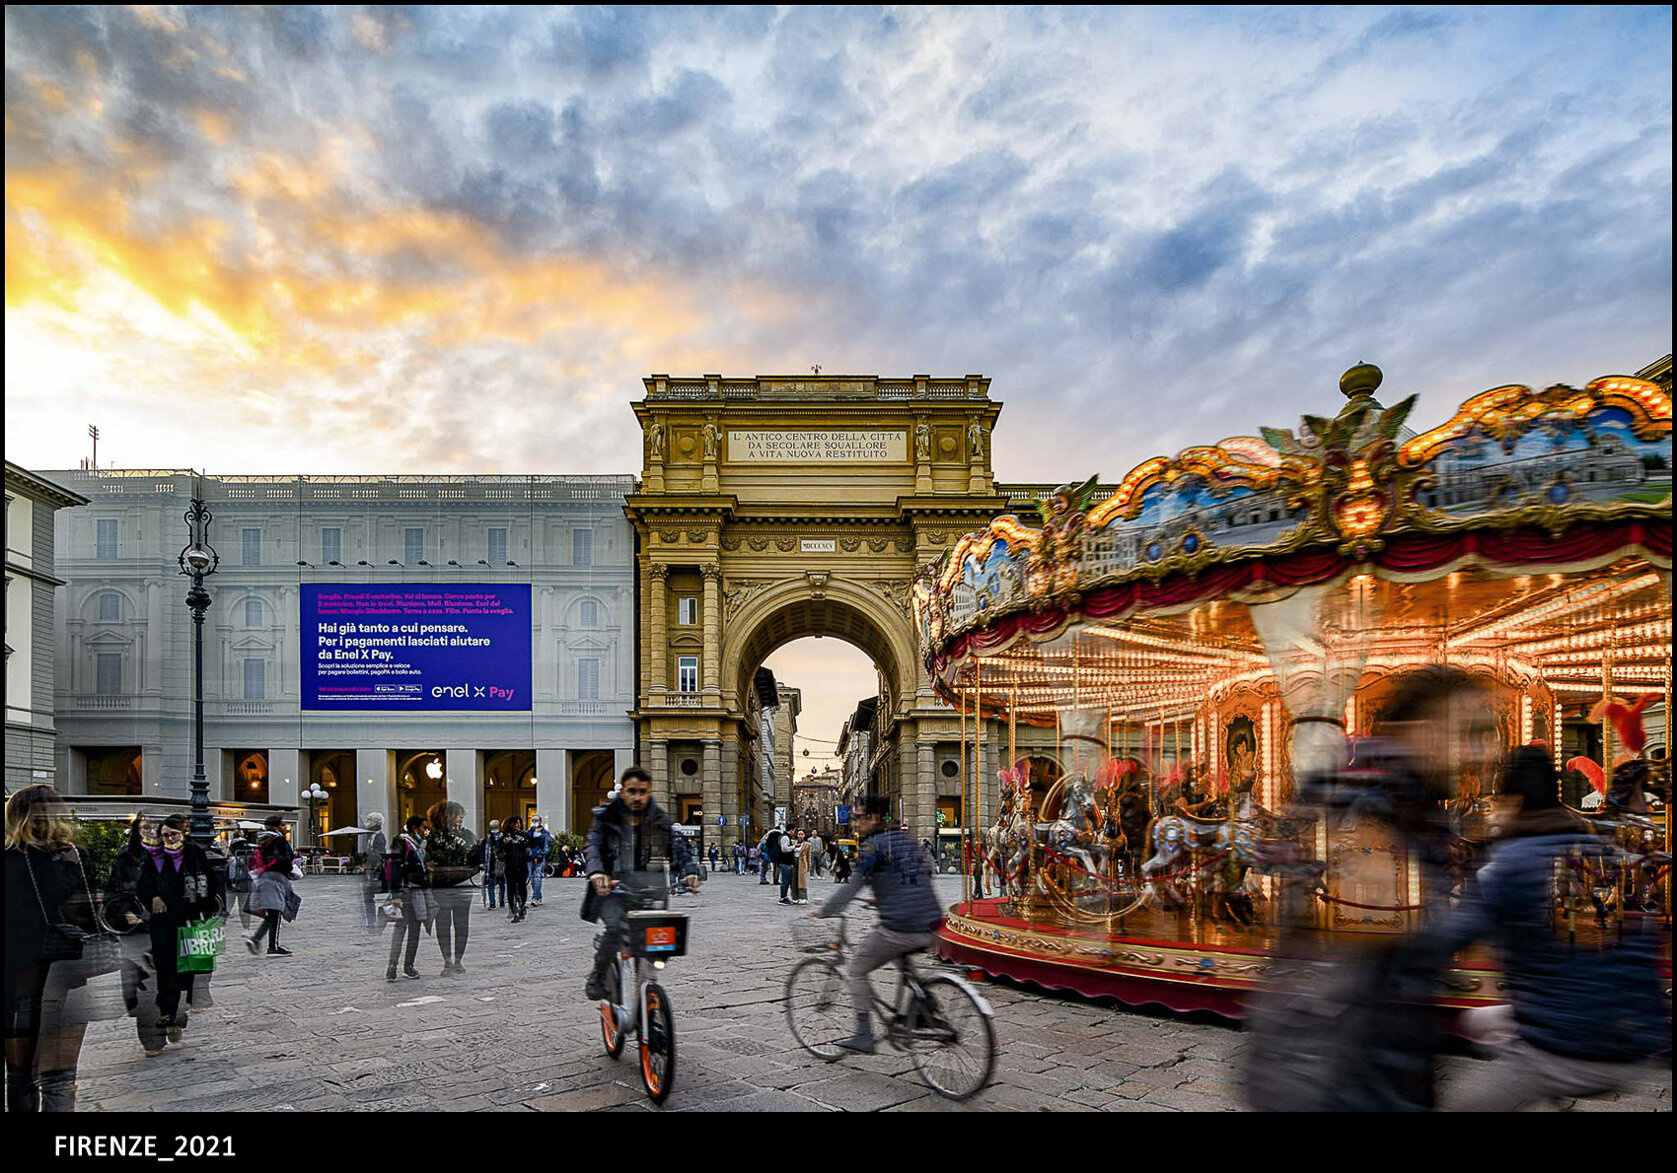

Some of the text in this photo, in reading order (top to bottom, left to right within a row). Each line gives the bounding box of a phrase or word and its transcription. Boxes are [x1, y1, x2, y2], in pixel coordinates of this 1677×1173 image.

[745, 433, 783, 441] ANTICO
[786, 433, 828, 441] CENTRO
[831, 433, 866, 441] DELLA
[748, 442, 887, 451] DA SECOLARE SQUALLORE
[748, 450, 887, 458] A VITA NUOVA RESTITUITO
[318, 622, 468, 635] Hai già tanto a cui pensare.
[318, 636, 490, 649] Per i pagamenti lasciati aiutare
[318, 650, 394, 662] da Enel X Pay.
[431, 684, 470, 698] enel
[489, 687, 515, 701] Pay
